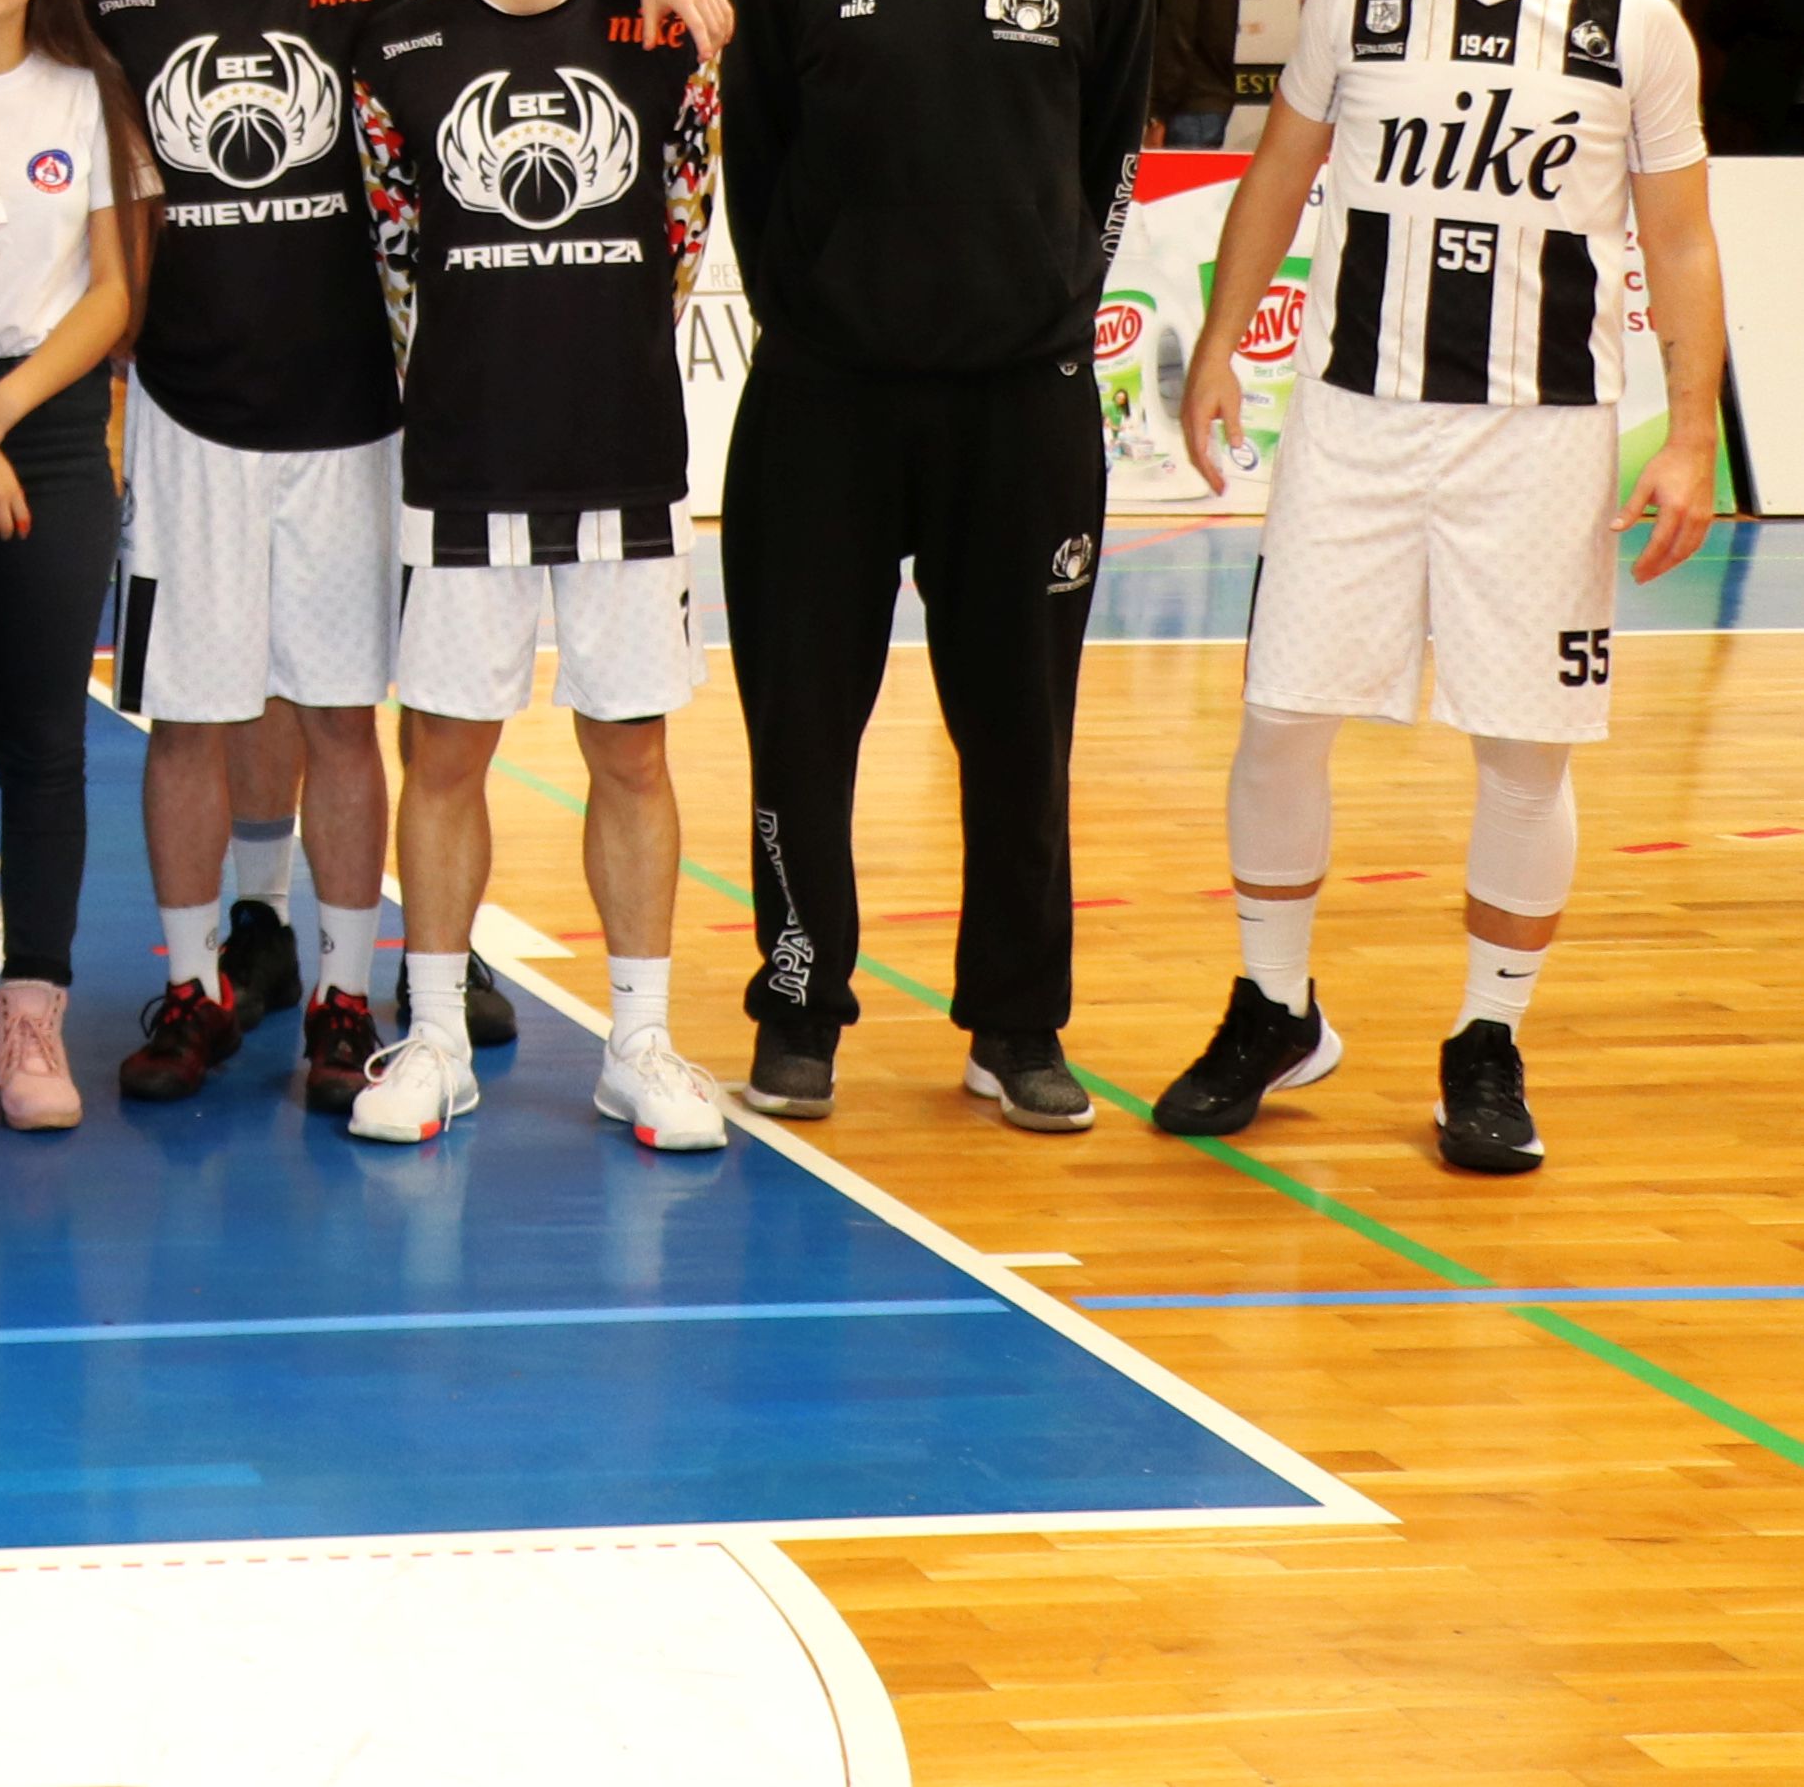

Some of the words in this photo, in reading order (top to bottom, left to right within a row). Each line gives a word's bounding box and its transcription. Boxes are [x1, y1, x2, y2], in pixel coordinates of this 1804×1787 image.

[383, 32, 443, 60] SPALDING
[1459, 34, 1510, 59] 1947
[217, 54, 274, 80] BC
[509, 92, 566, 118] BC
[1374, 87, 1581, 201] niké
[162, 190, 348, 229] PRIEVIDZA
[445, 238, 643, 272] PRIEVIDZA
[1437, 226, 1493, 273] 55
[1558, 628, 1610, 688] 55
